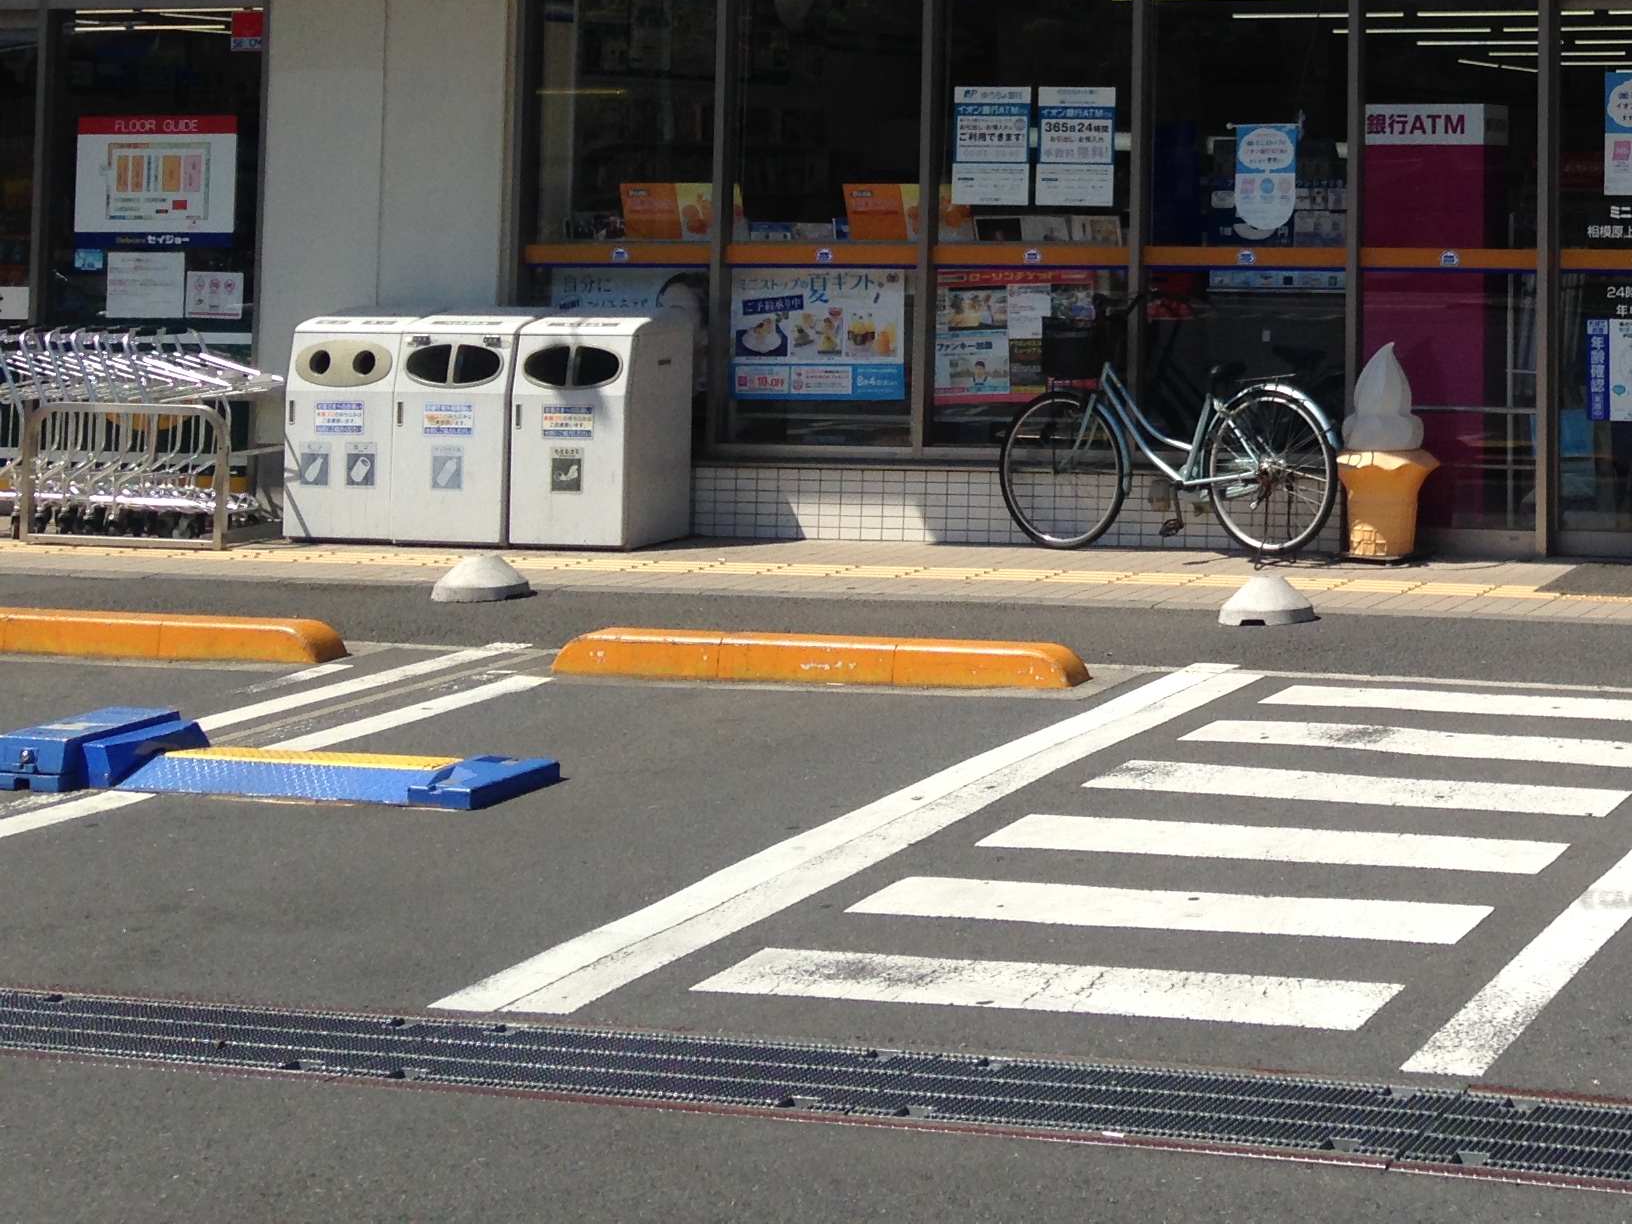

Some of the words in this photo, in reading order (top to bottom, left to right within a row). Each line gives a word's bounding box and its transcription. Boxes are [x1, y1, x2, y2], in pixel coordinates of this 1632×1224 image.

[114, 119, 156, 132] FLOOR
[163, 119, 199, 132] GUIDE
[1366, 113, 1466, 136] 銀行ATM
